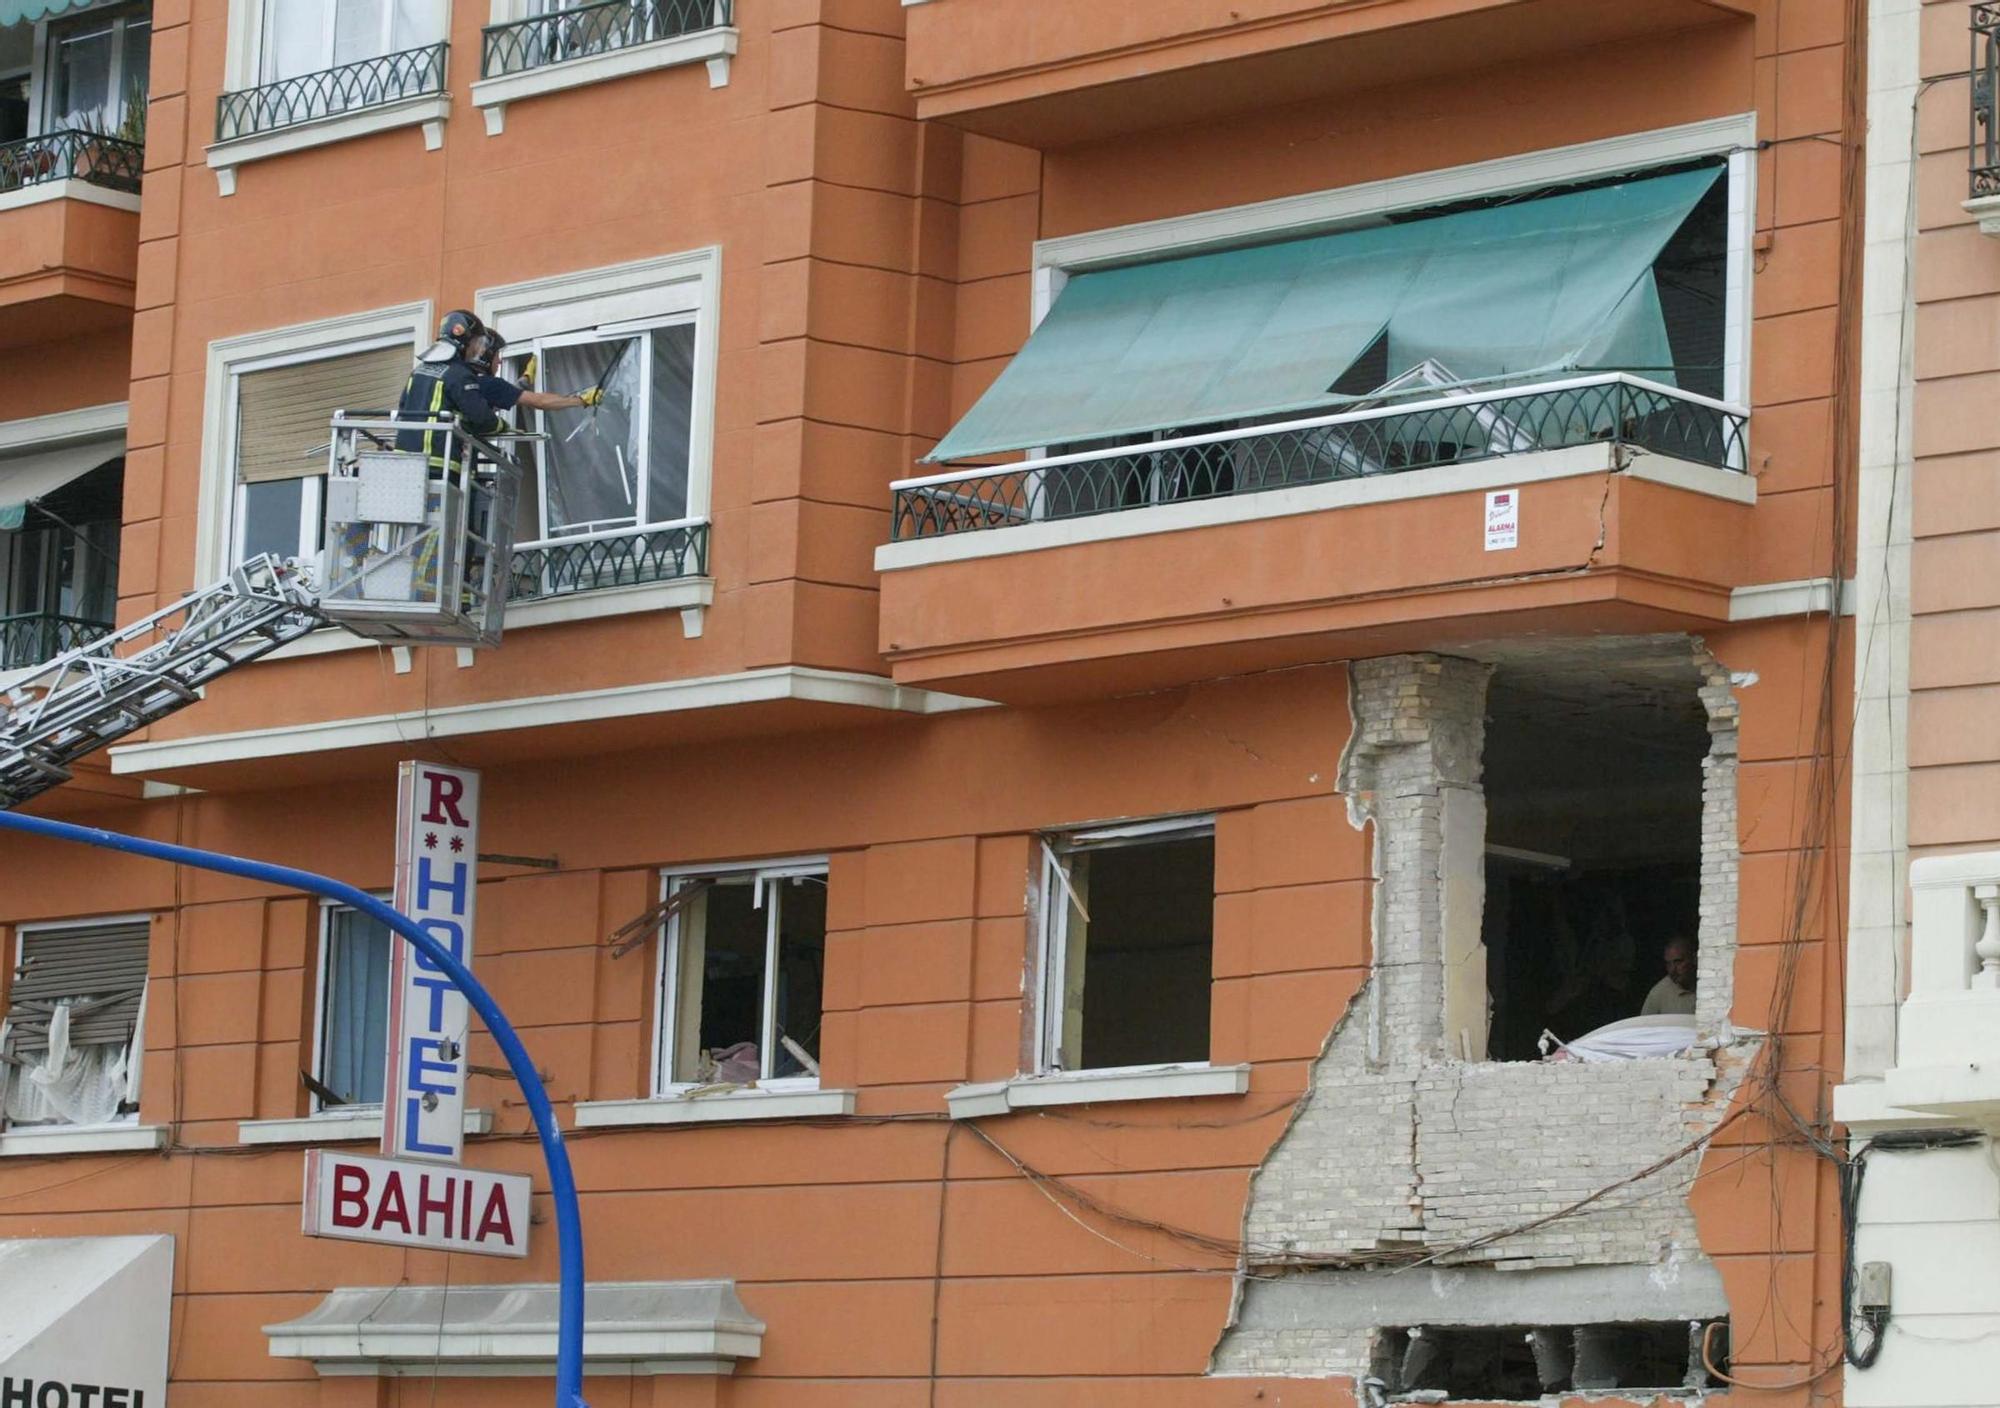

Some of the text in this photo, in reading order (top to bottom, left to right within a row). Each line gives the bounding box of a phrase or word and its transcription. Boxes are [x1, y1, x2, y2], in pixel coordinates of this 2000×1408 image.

[1488, 522, 1515, 532] ALARMA
[404, 857, 467, 1155] HOTEL
[332, 1164, 514, 1246] BAHIA
